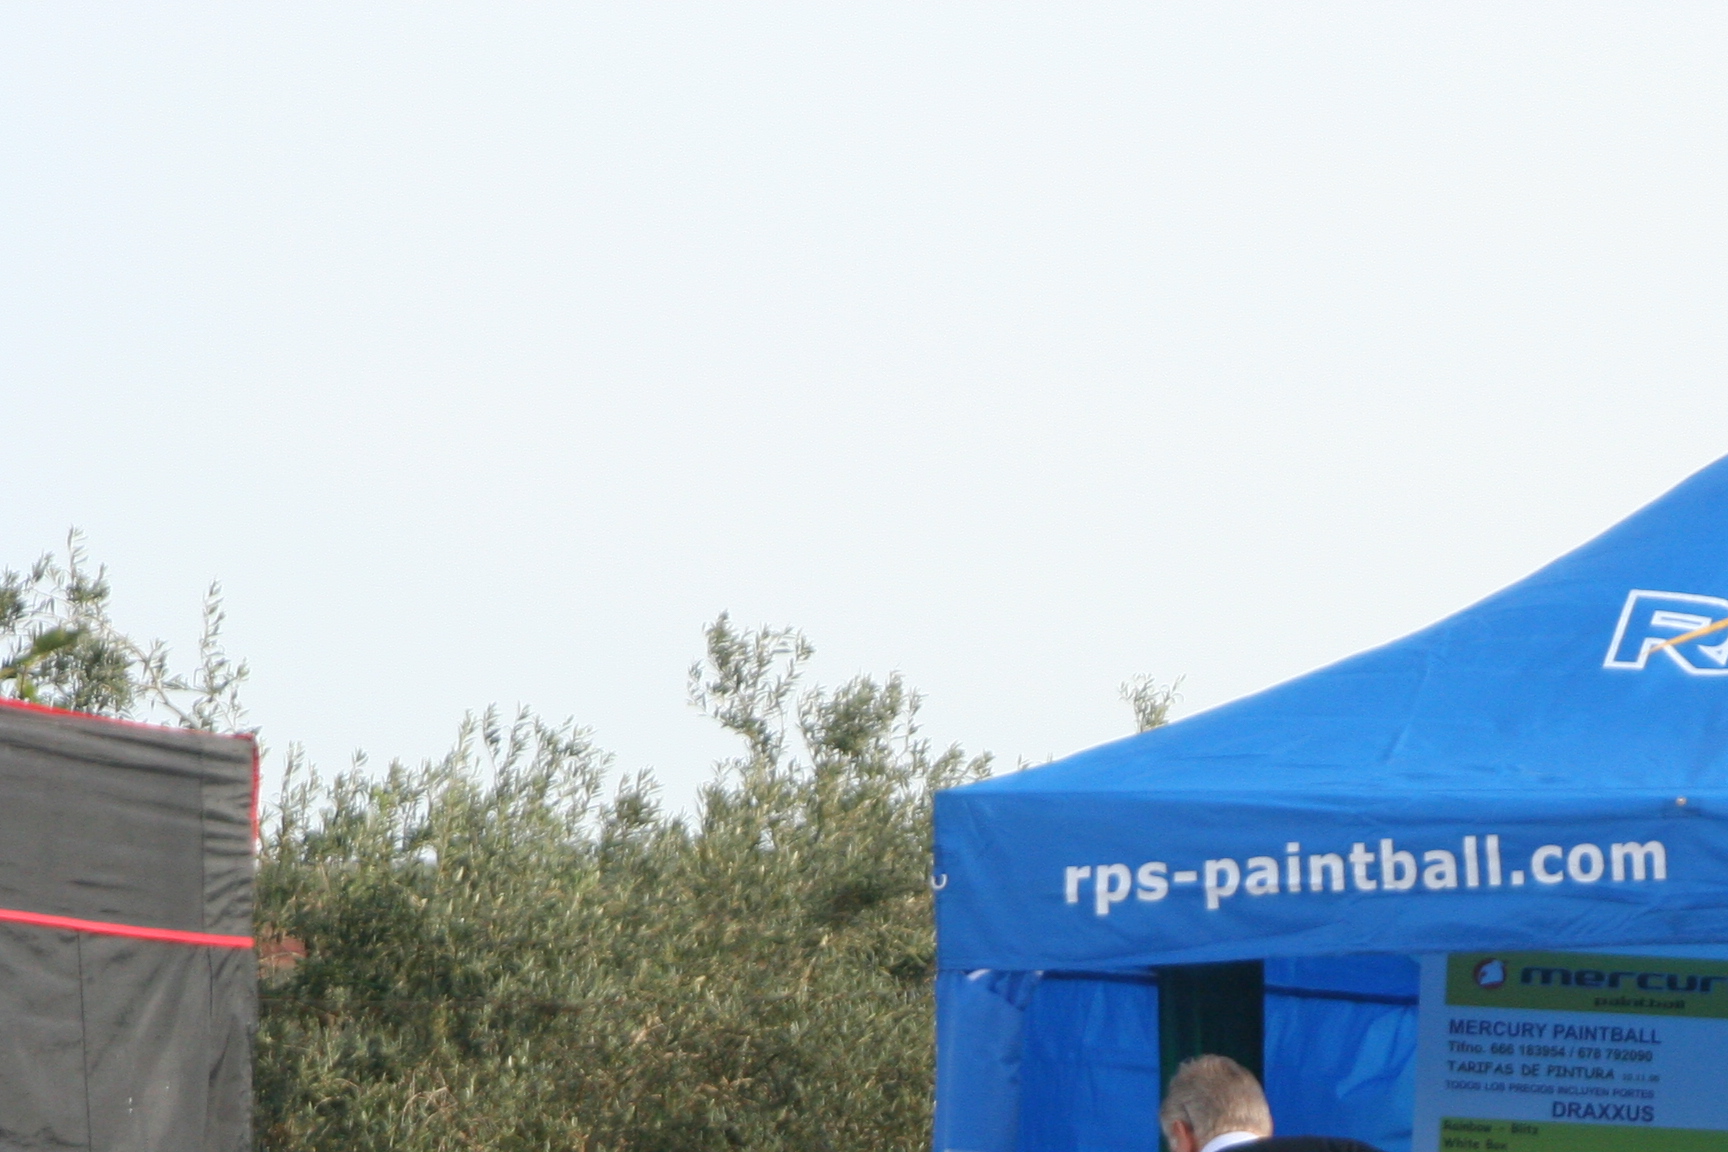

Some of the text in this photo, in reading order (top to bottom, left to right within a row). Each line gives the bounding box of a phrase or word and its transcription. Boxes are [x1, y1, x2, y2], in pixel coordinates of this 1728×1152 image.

[1063, 832, 1668, 917] rps-paintball.com
[1449, 1018, 1662, 1044] MERCURY PAINTBALL
[1447, 1059, 1514, 1075] TARIFAS
[1521, 1063, 1540, 1077] DE
[1547, 1066, 1615, 1080] PINTURA
[1509, 1082, 1555, 1094] PRECIOS
[1558, 1085, 1609, 1097] INCLUYEN
[1612, 1088, 1655, 1099] PORTES
[1552, 1101, 1655, 1122] DRAXXUS
